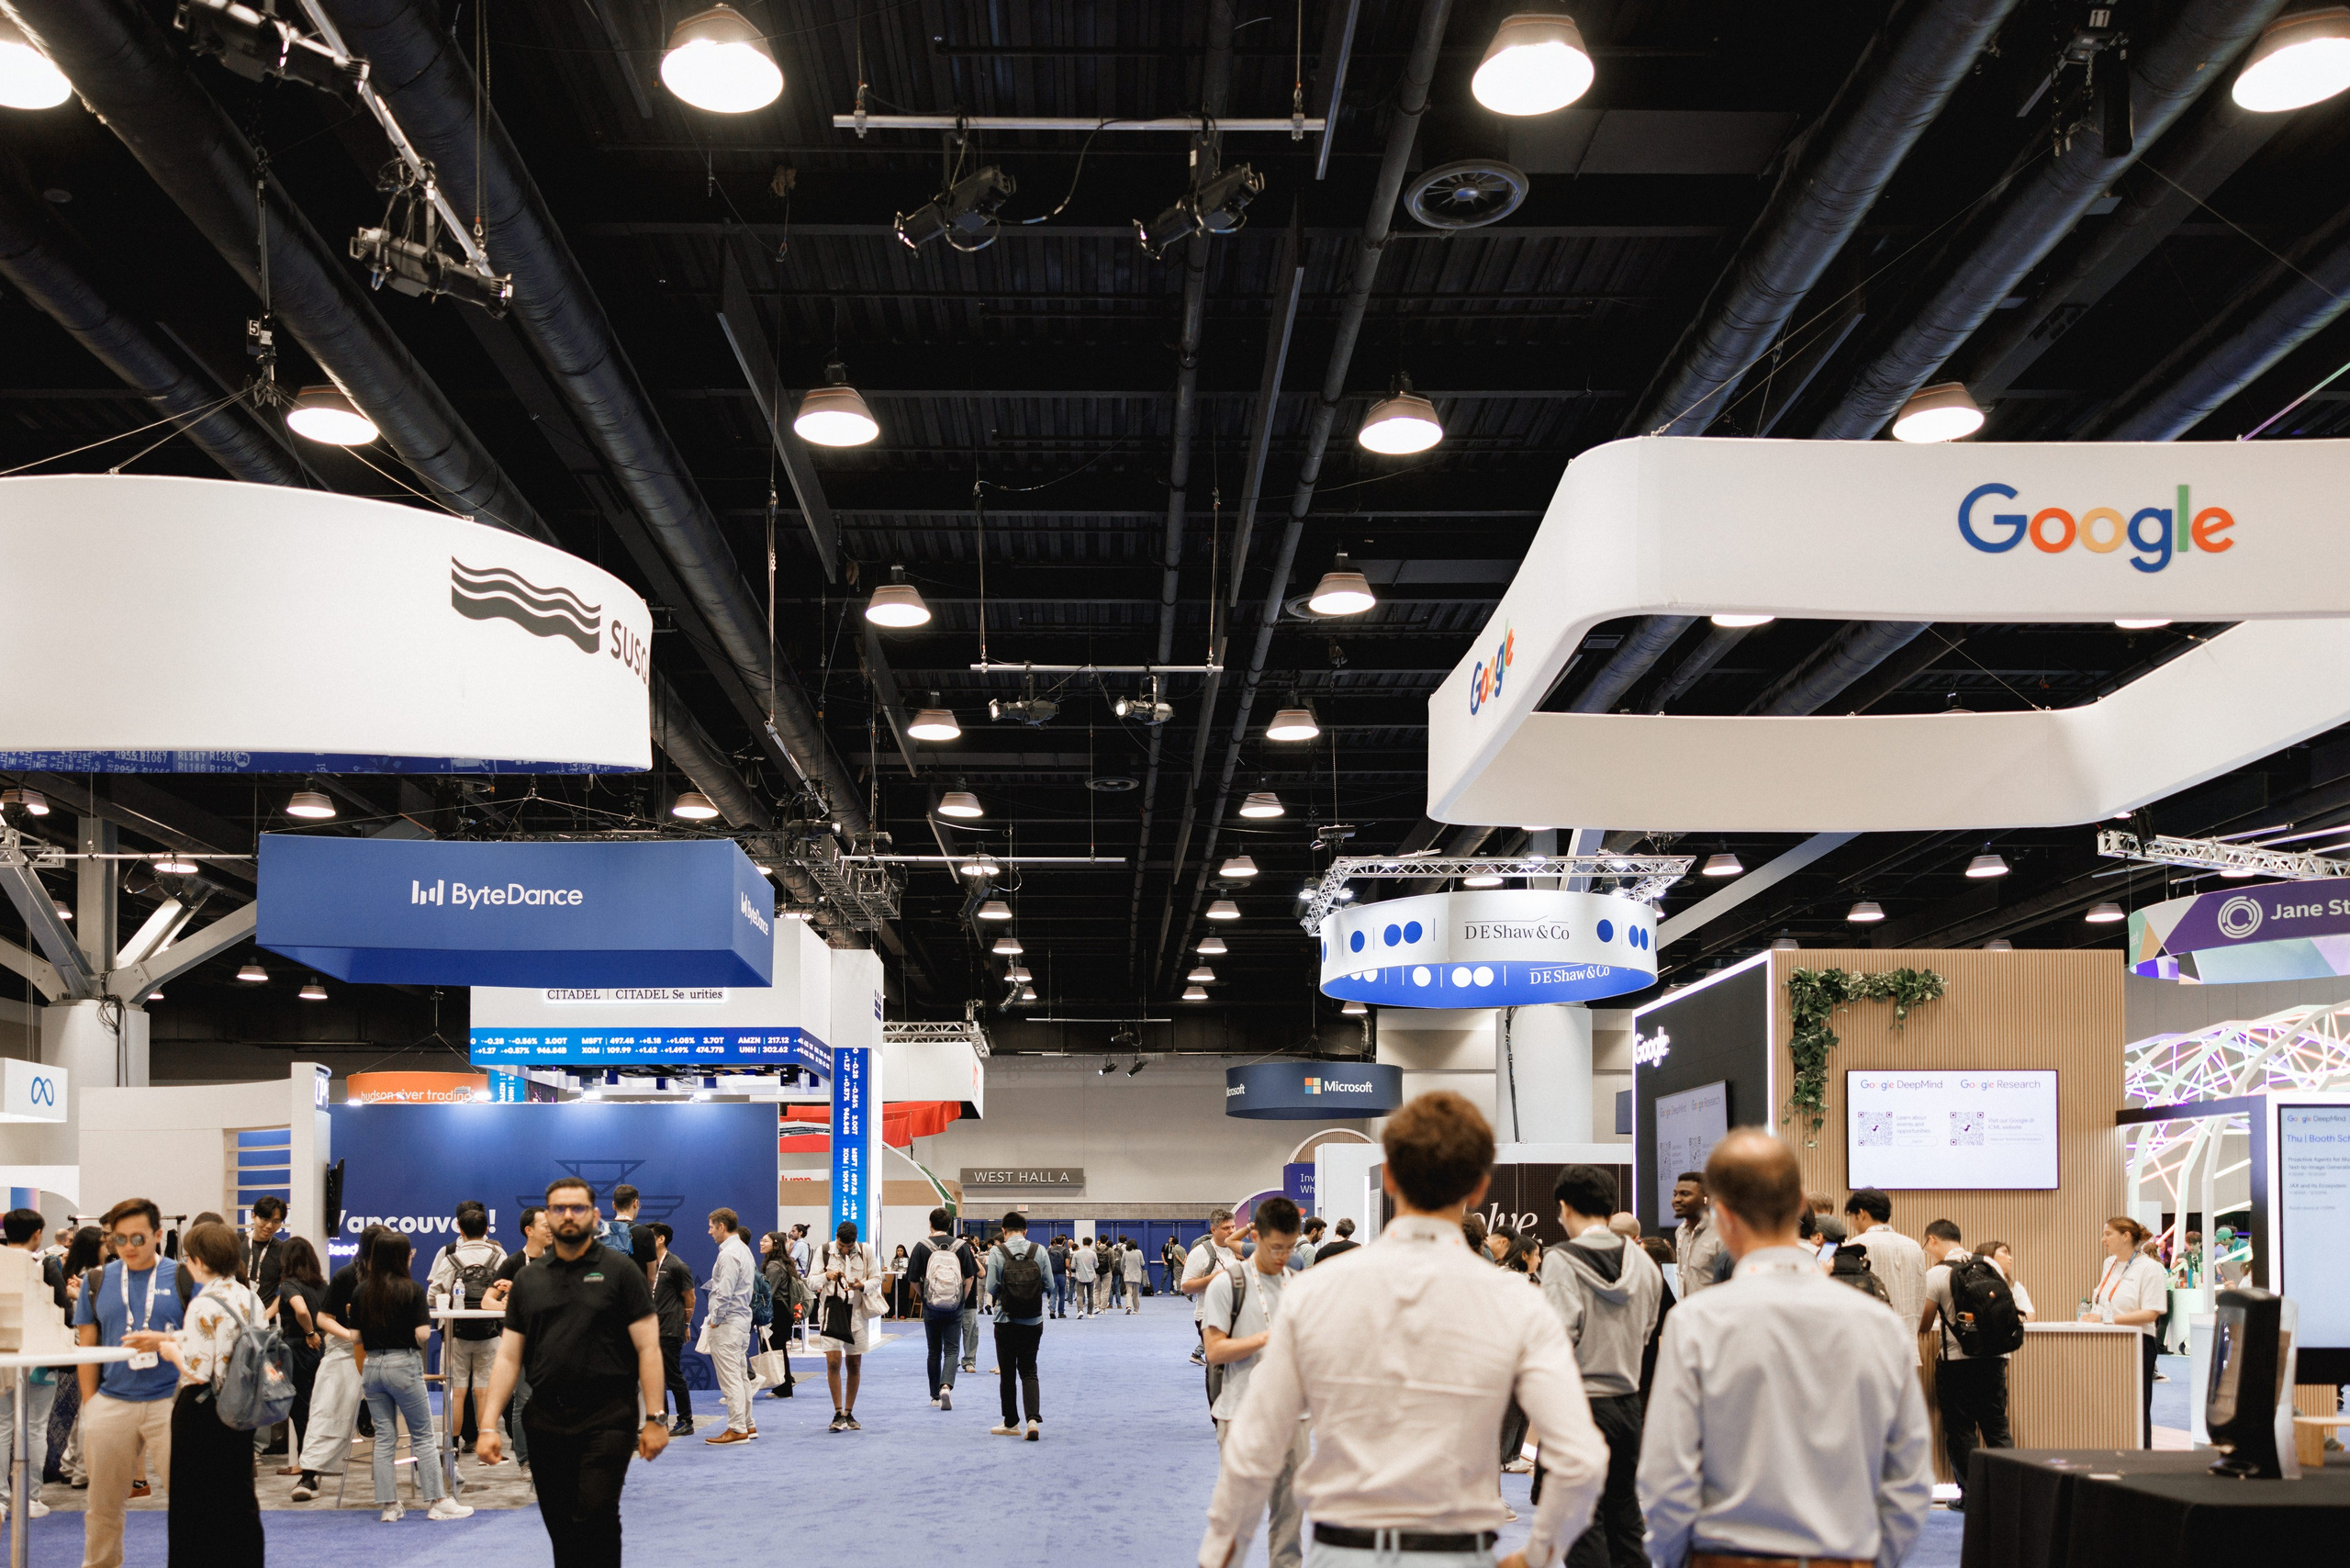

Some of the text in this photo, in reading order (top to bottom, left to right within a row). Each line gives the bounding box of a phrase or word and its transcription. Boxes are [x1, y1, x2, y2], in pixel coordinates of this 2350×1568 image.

[251, 321, 258, 334] 5
[1958, 482, 2235, 573] Google
[1470, 617, 1515, 715] Google
[452, 882, 583, 910] ByteDance
[2270, 902, 2323, 920] Jane
[1494, 924, 1534, 939] Shaw
[1553, 969, 1586, 982] Shaw
[547, 989, 722, 1000] CITADEL CITADEL Seurities
[703, 1036, 724, 1045] 3.70T
[738, 1036, 761, 1045] AMZN
[767, 1036, 789, 1045] 217.12
[1635, 1025, 1670, 1068] Google
[1324, 1081, 1372, 1093] Microsoft
[1861, 1080, 1943, 1092] Google DeepMind
[1960, 1080, 2041, 1091] Google Research
[2287, 1134, 2302, 1143] Thu
[2309, 1134, 2335, 1143] Booth
[974, 1171, 1069, 1182] WEST HALL A
